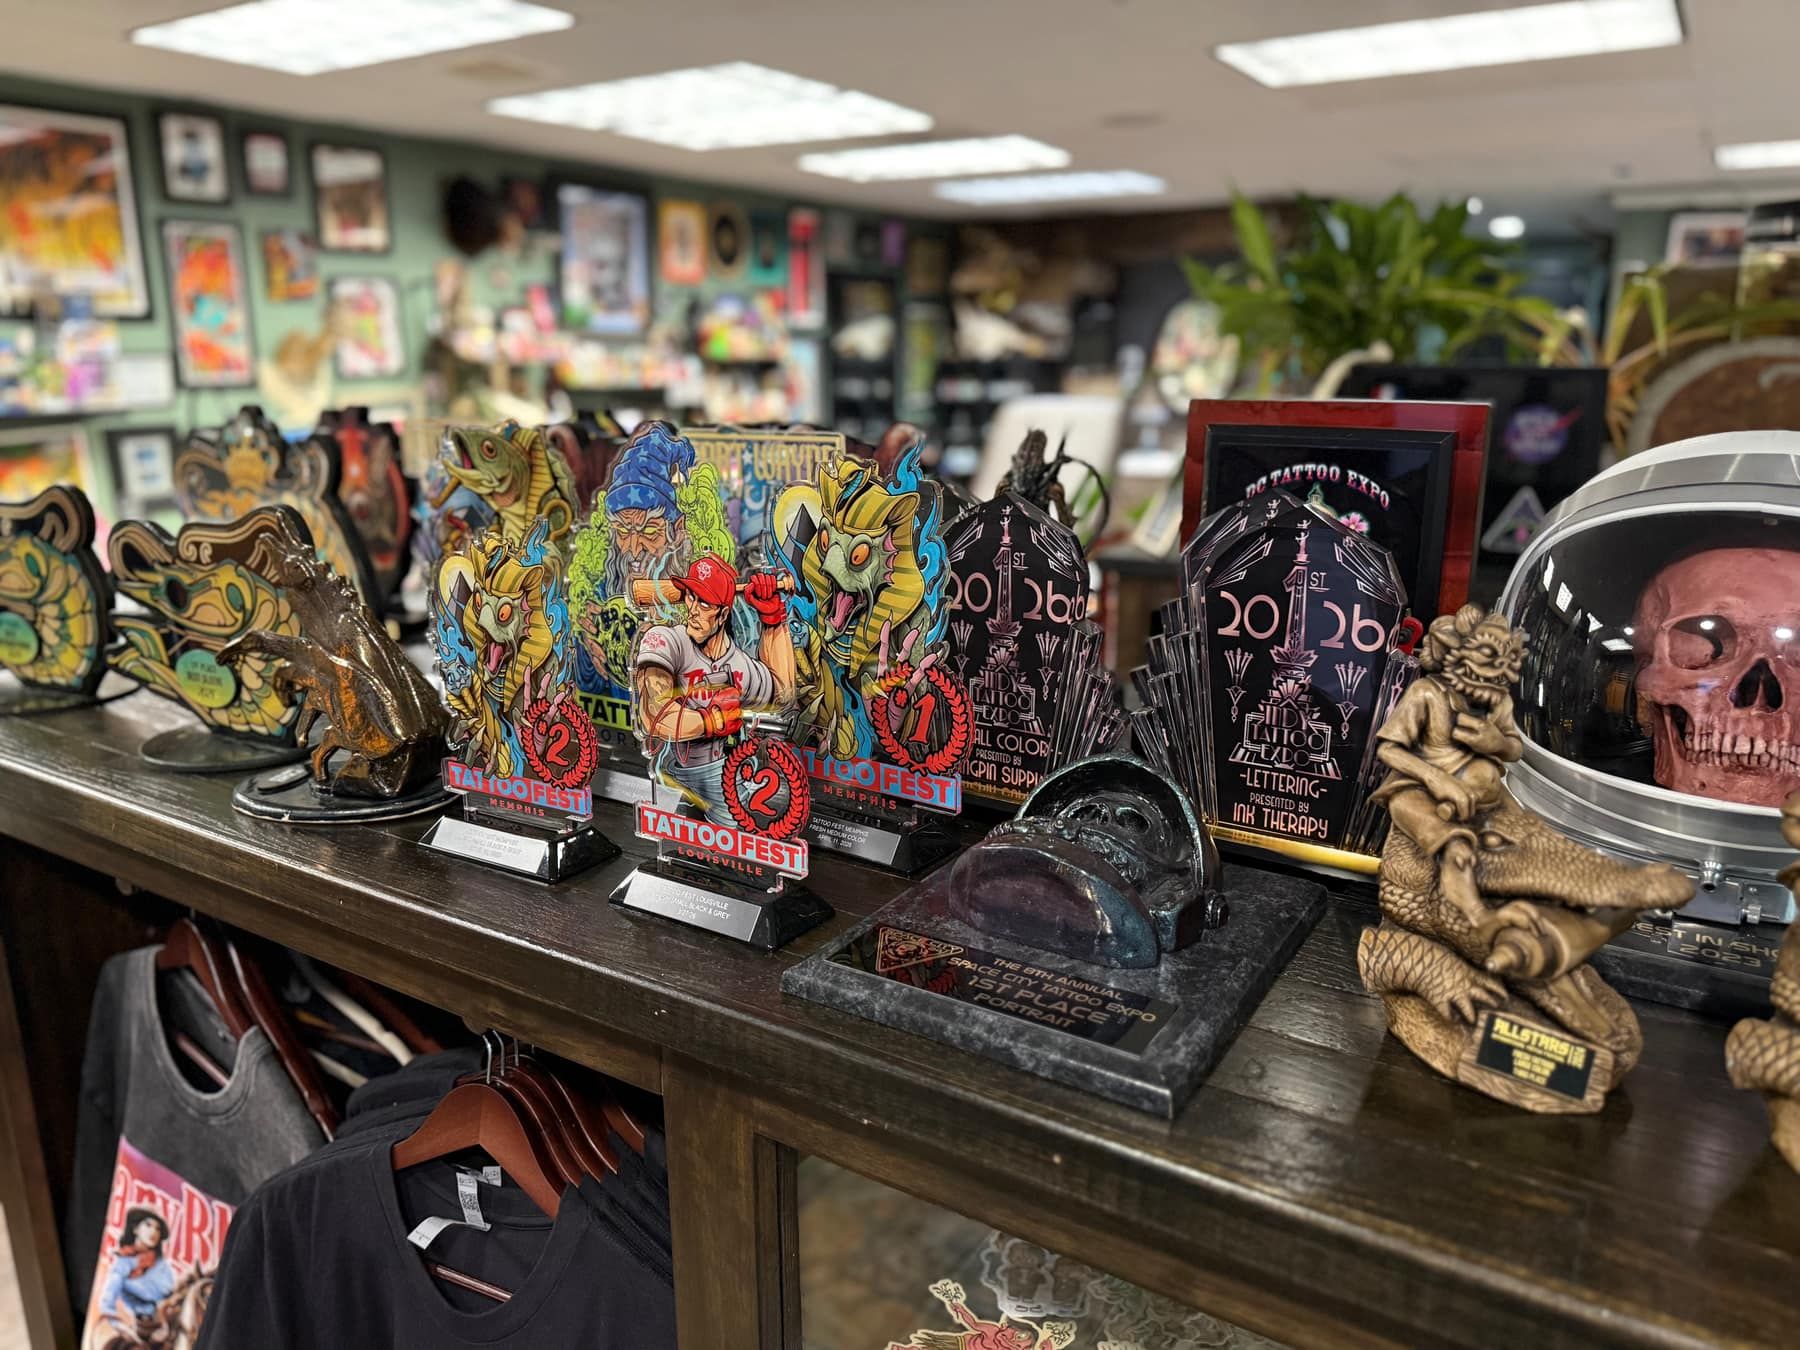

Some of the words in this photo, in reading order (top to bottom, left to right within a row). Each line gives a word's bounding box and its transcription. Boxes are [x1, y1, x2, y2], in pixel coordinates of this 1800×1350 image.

[701, 441, 748, 481] ORT
[1270, 464, 1341, 487] TATTOO
[1347, 469, 1390, 510] EXPO
[1217, 590, 1280, 640] 20
[1320, 600, 1386, 652] 26
[579, 696, 632, 727] TATT
[974, 686, 1031, 710] TATTOO
[974, 728, 992, 747] ALL
[996, 733, 1049, 758] COLOR
[1251, 723, 1325, 750] TATTOO
[975, 748, 1011, 763] PRESENTED
[1013, 755, 1022, 766] BY
[1261, 743, 1311, 767] EXPO
[451, 766, 529, 800] TATTOO
[533, 783, 582, 811] FEST
[798, 747, 876, 787] TTOO
[884, 768, 950, 803] FEST
[1001, 766, 1043, 788] SUPPL
[489, 797, 545, 817] MEMPHIS
[823, 785, 897, 810] MEMPHIS
[1249, 792, 1296, 810] PRESENTED
[1298, 801, 1310, 814] BY
[1233, 802, 1256, 825] INK
[1262, 807, 1329, 839] THERAPY
[643, 810, 734, 851] TATTOO
[740, 834, 800, 868] FEST
[678, 846, 763, 876] LOUISVILLE
[1632, 922, 1687, 939] EST
[1729, 940, 1779, 962] SH
[1679, 944, 1762, 968] 2023
[947, 957, 1002, 977] SPACE
[1003, 972, 1039, 988] CITY
[1041, 983, 1103, 1007] TATTOO
[1105, 1003, 1157, 1023] EXPO
[993, 958, 1020, 972] THE
[1055, 976, 1125, 1001] ANNUAL
[968, 975, 1011, 995] 1ST
[1016, 989, 1111, 1025] PLACE
[973, 993, 1076, 1028] PORTRAIT
[1492, 1017, 1571, 1057] ALLSTARS
